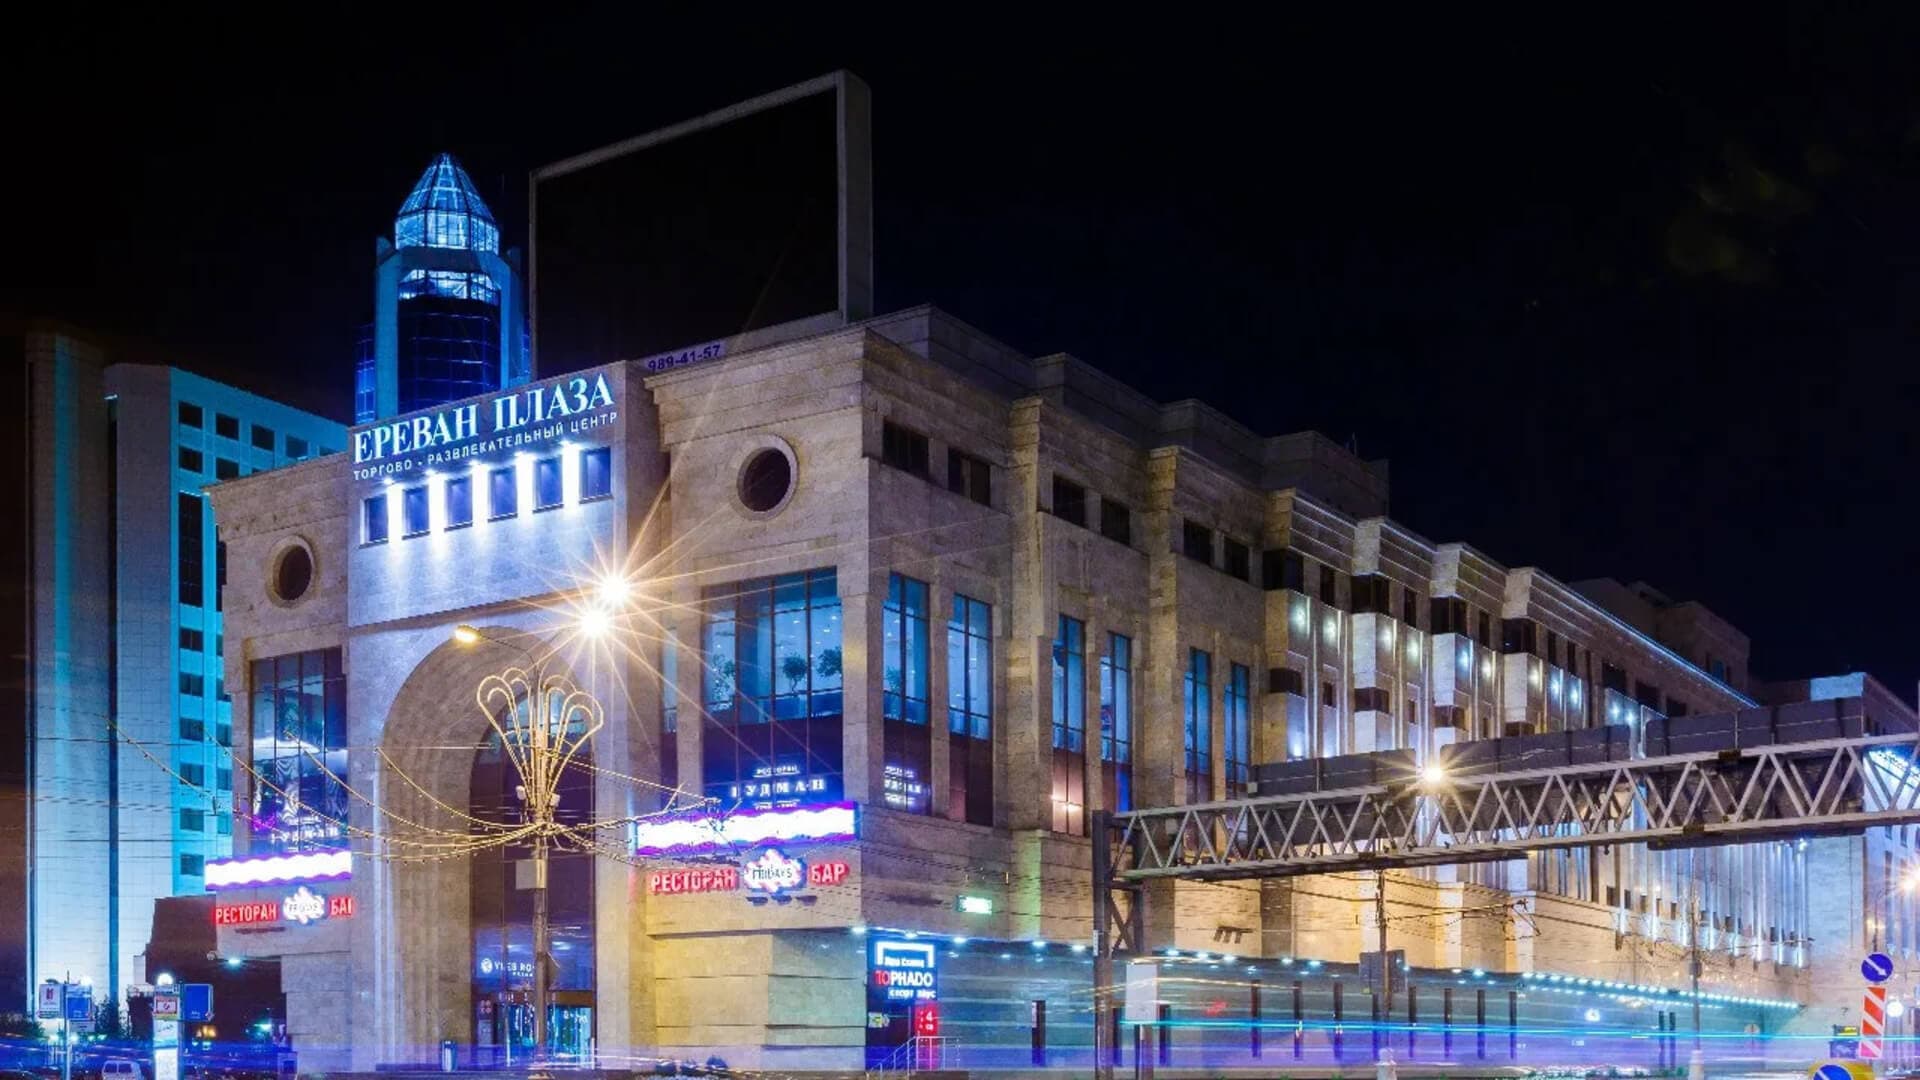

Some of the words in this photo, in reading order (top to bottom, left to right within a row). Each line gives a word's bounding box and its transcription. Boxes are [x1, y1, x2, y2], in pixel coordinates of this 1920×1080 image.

[648, 343, 721, 372] 989-41-57
[354, 402, 479, 464] ЕРЕВАН
[493, 372, 615, 434] ПЛАЗА
[353, 459, 412, 481] ТОРГОВО
[427, 420, 564, 465] РАЗВЛЕКАТЕЛЬНЫЙ
[570, 412, 618, 437] ЦЕНТР
[651, 868, 737, 894] РЕСТОРАН
[810, 862, 848, 885] БАР
[215, 904, 277, 924] РЕСТОРАН
